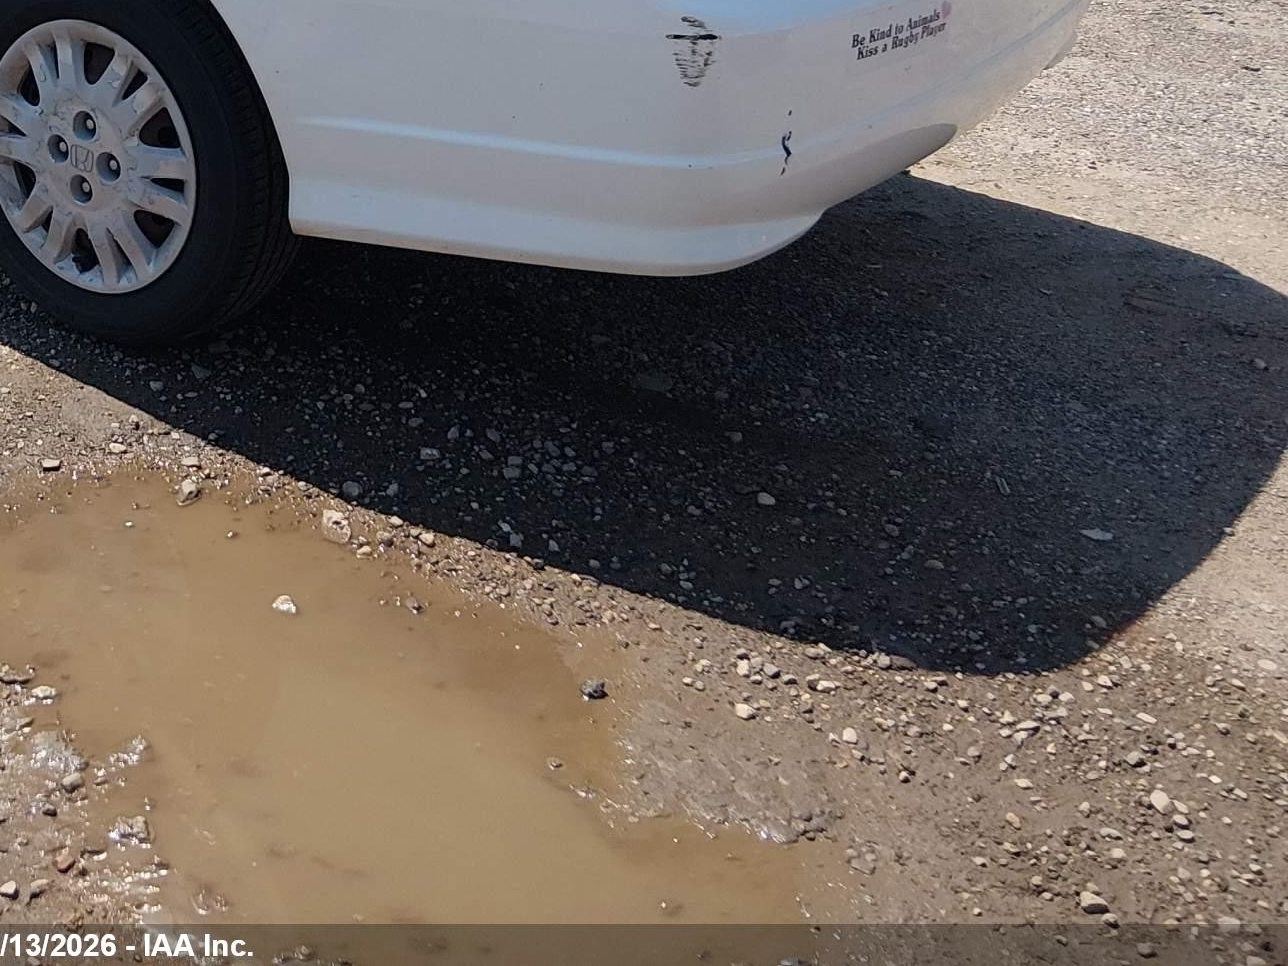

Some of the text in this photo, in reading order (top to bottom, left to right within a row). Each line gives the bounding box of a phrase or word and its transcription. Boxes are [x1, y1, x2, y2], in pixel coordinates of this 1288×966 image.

[851, 9, 941, 49] Be Kind to Animals
[856, 22, 947, 60] Kiss a Rugby Player
